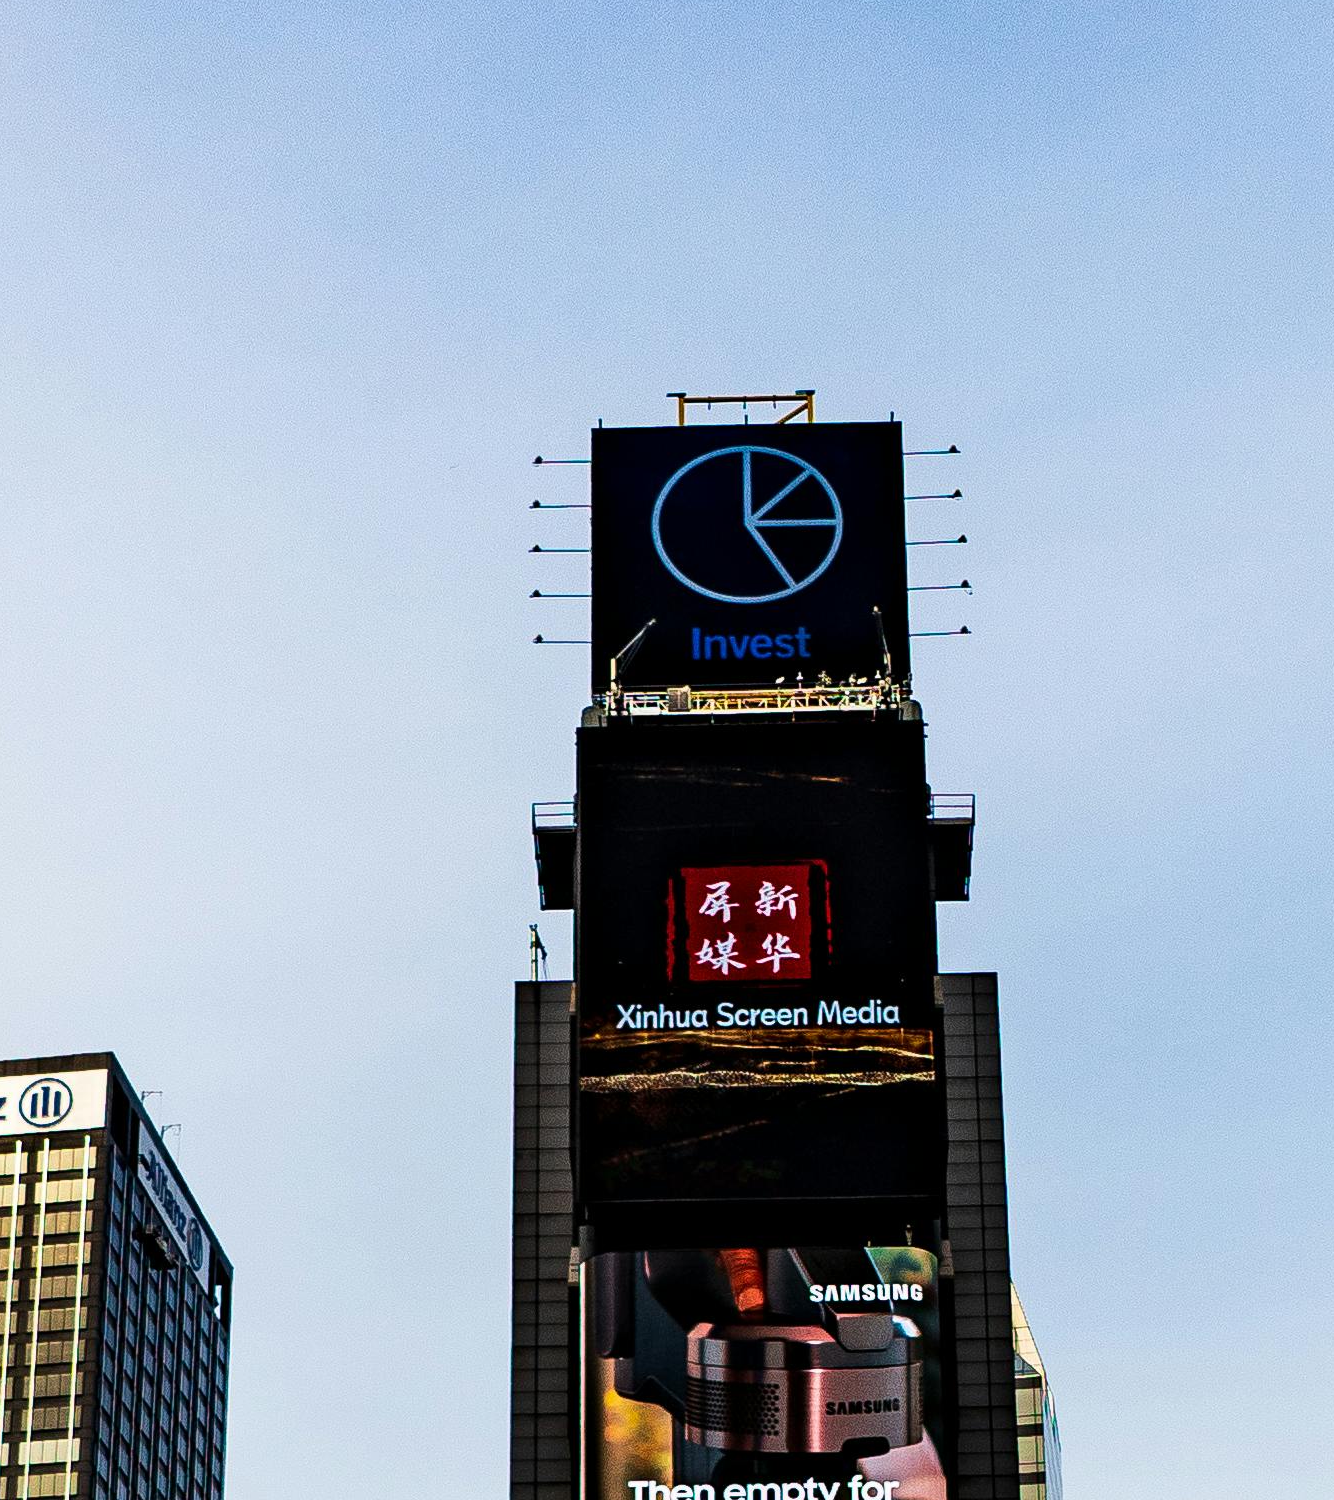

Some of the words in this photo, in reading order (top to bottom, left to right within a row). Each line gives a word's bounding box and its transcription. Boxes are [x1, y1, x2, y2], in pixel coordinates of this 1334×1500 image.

[691, 625, 811, 660] Invest
[616, 1002, 709, 1030] Xinhua
[717, 1001, 810, 1029] Screen
[818, 999, 900, 1026] Media
[809, 1284, 923, 1303] SAMSUNG
[825, 1397, 901, 1416] SAMSUNG
